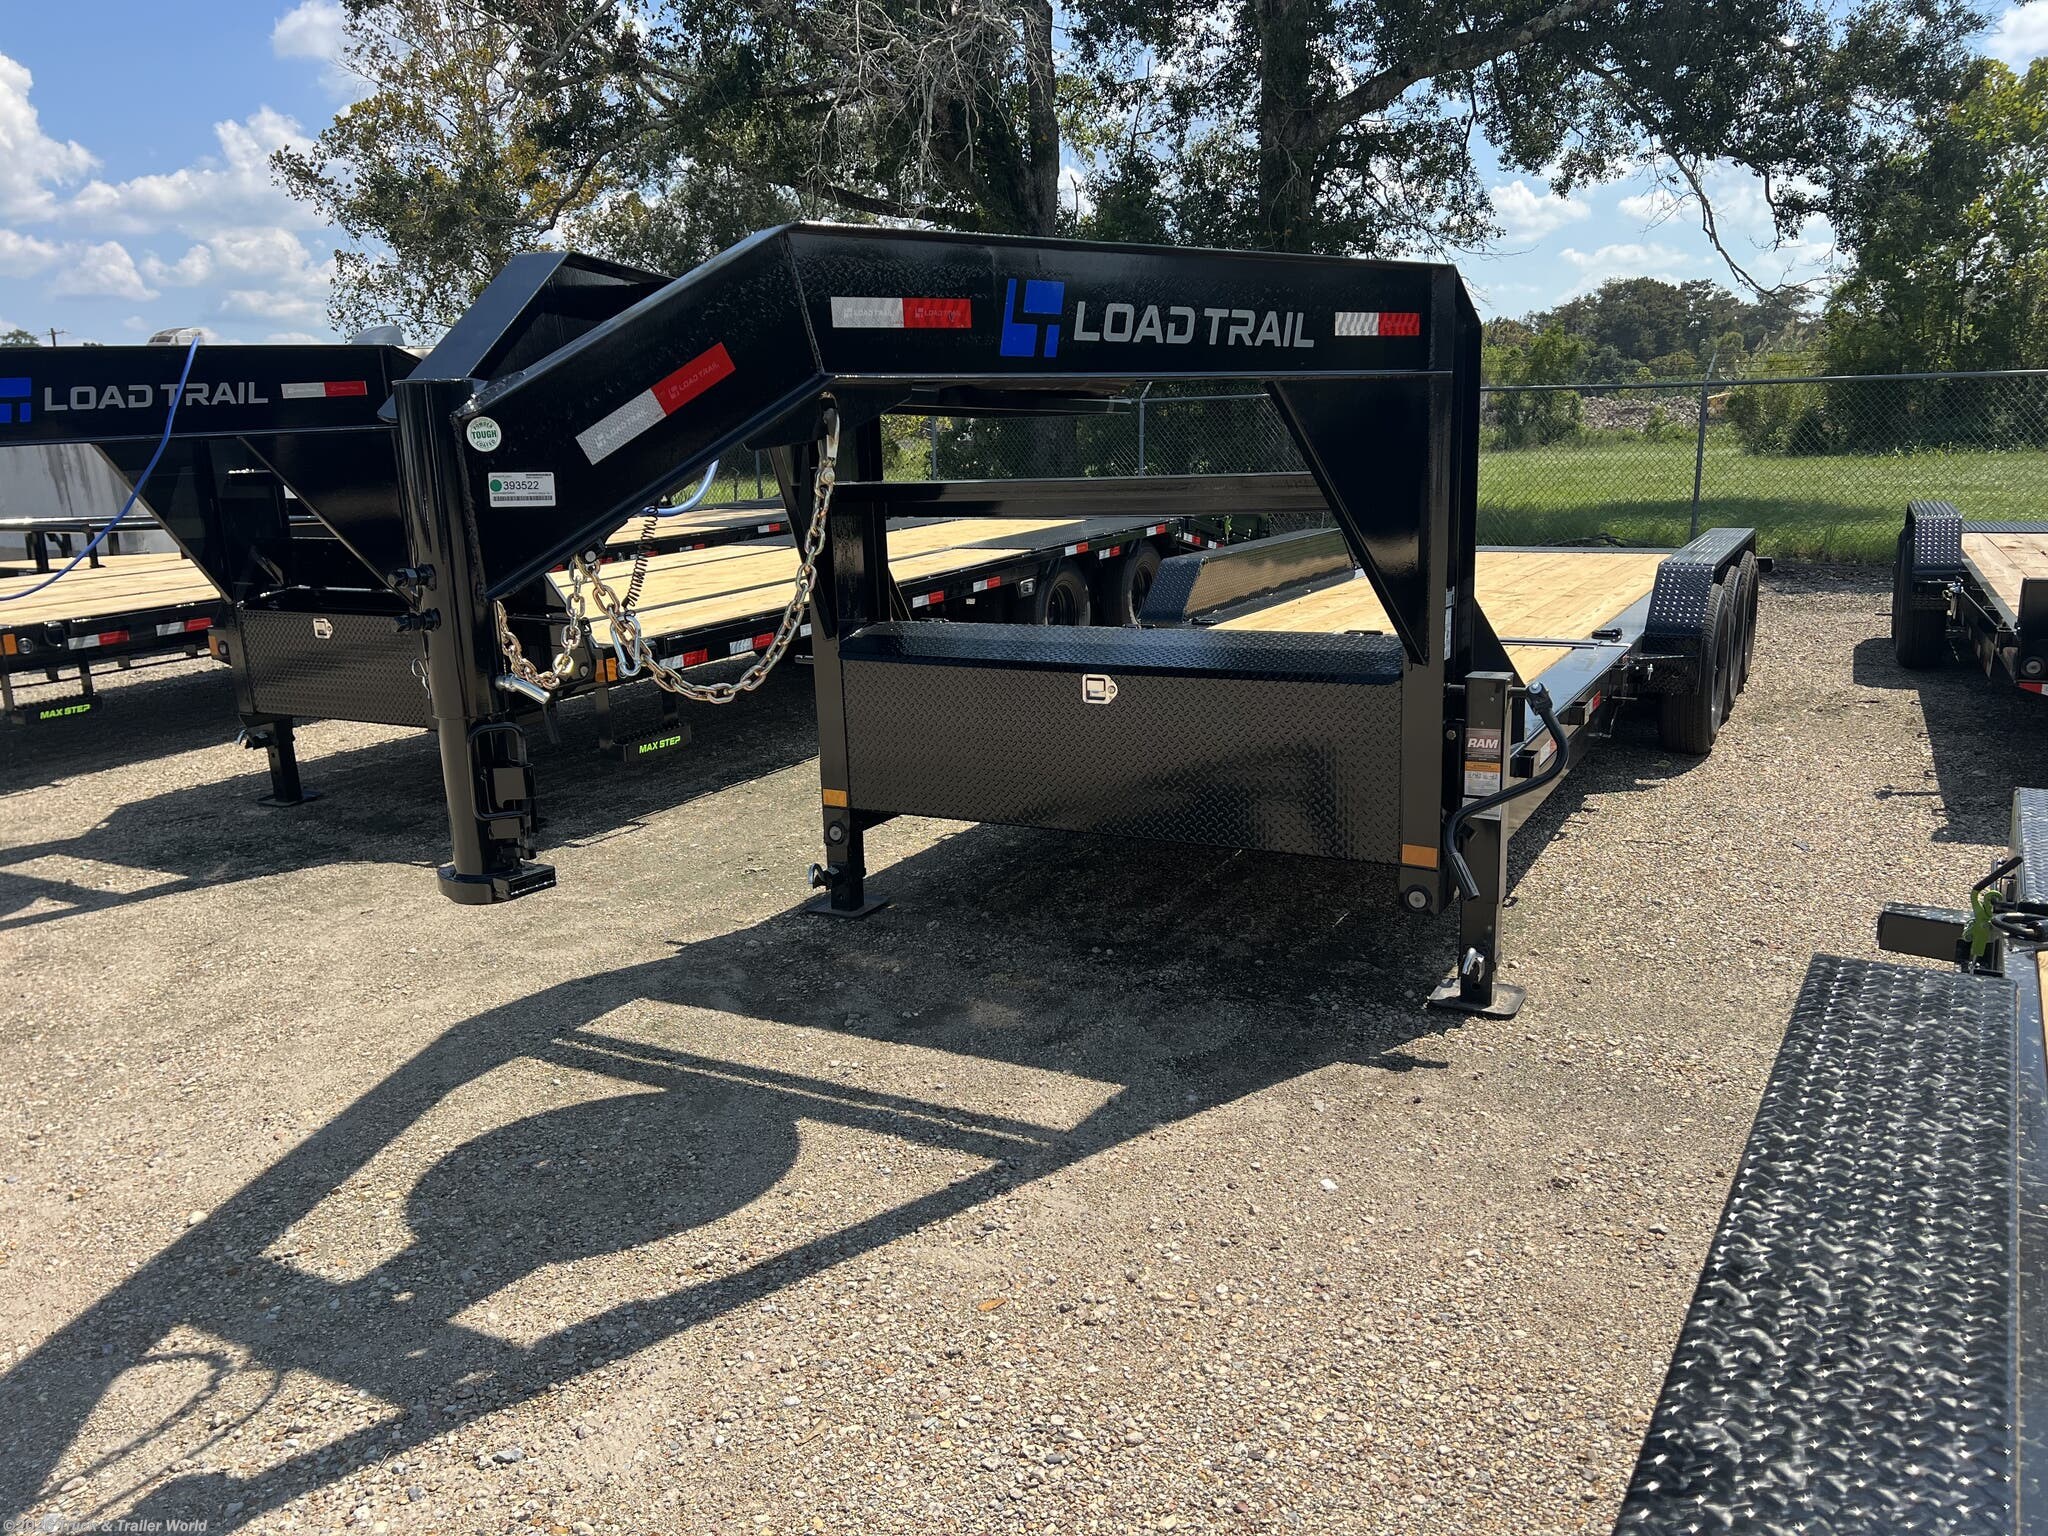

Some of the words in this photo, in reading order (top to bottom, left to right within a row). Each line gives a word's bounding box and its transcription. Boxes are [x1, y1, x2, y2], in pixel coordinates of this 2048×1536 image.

[1073, 301, 1196, 344] LOAD
[1204, 308, 1314, 348] TRAIL
[678, 372, 699, 391] LOAD
[44, 384, 153, 411] LOAD
[160, 381, 269, 407] TRAIL
[471, 430, 497, 439] TOUGH
[503, 480, 539, 490] 393522
[40, 709, 63, 720] MAX
[64, 704, 91, 715] STEP
[639, 741, 659, 754] MAX
[659, 735, 681, 748] STEP
[1467, 738, 1499, 749] RAM
